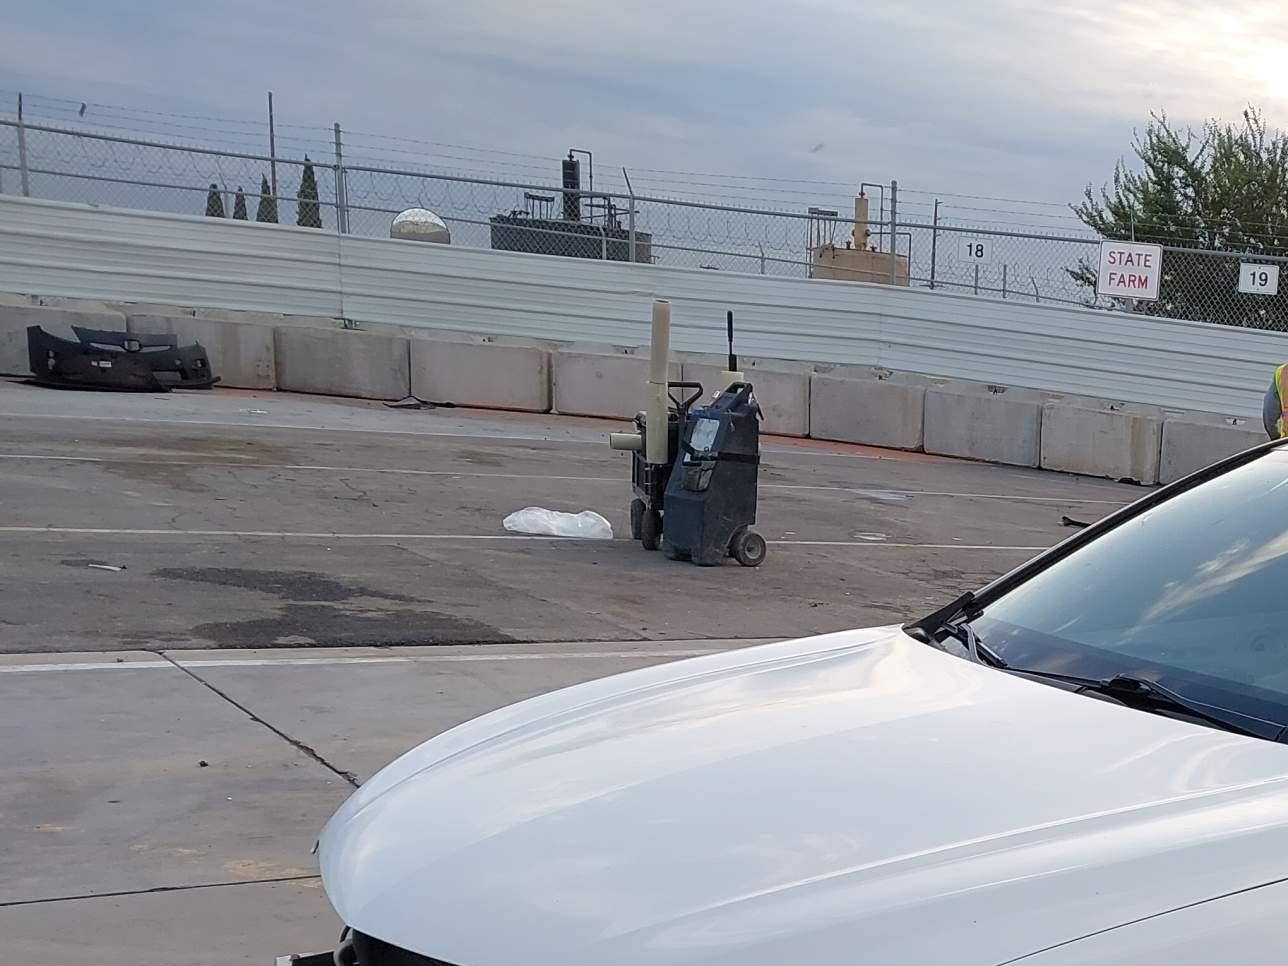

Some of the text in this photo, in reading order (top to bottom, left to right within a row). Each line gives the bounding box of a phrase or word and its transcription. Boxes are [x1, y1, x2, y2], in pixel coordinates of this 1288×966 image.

[967, 243, 984, 258] 18
[1108, 250, 1152, 268] STATE
[1108, 272, 1148, 289] FARM
[1250, 271, 1268, 287] 19
